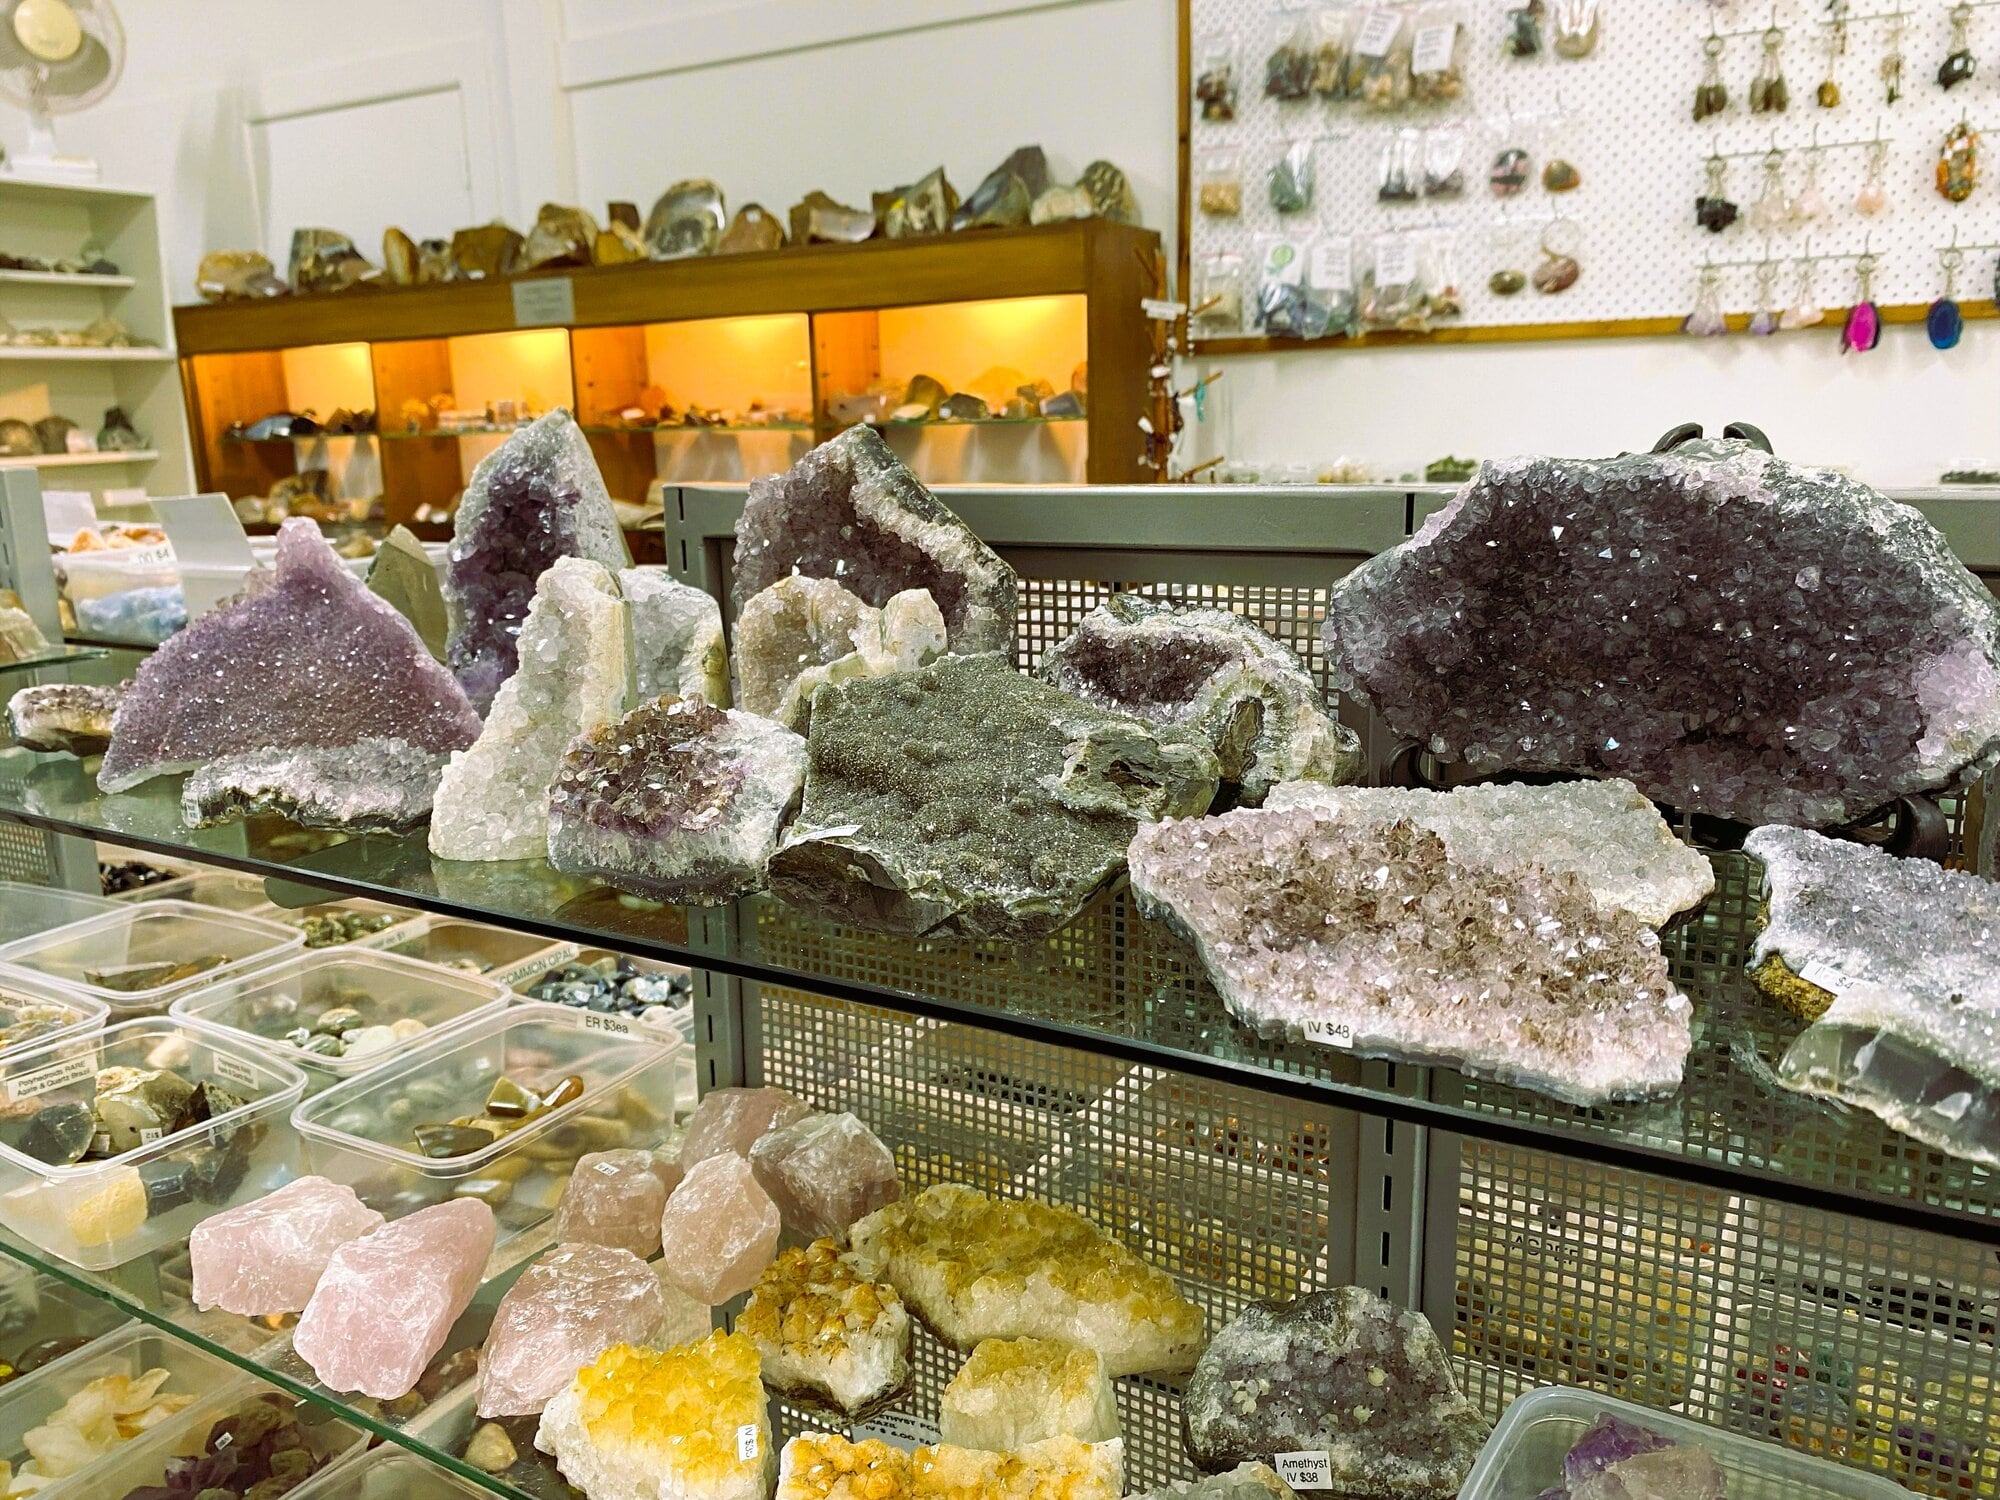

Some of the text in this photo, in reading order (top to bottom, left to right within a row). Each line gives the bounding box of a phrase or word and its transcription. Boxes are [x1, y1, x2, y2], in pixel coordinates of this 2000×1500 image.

[501, 960, 547, 985] COMMON
[585, 1015, 629, 1034] ER $3ea
[1307, 1020, 1350, 1039] IV $48
[65, 1060, 86, 1072] RARE
[39, 1081, 46, 1090] &
[47, 1074, 70, 1087] Quartz
[744, 1426, 754, 1436] IV
[1281, 1457, 1328, 1470] Amethyst
[1286, 1471, 1319, 1483] IV $38
